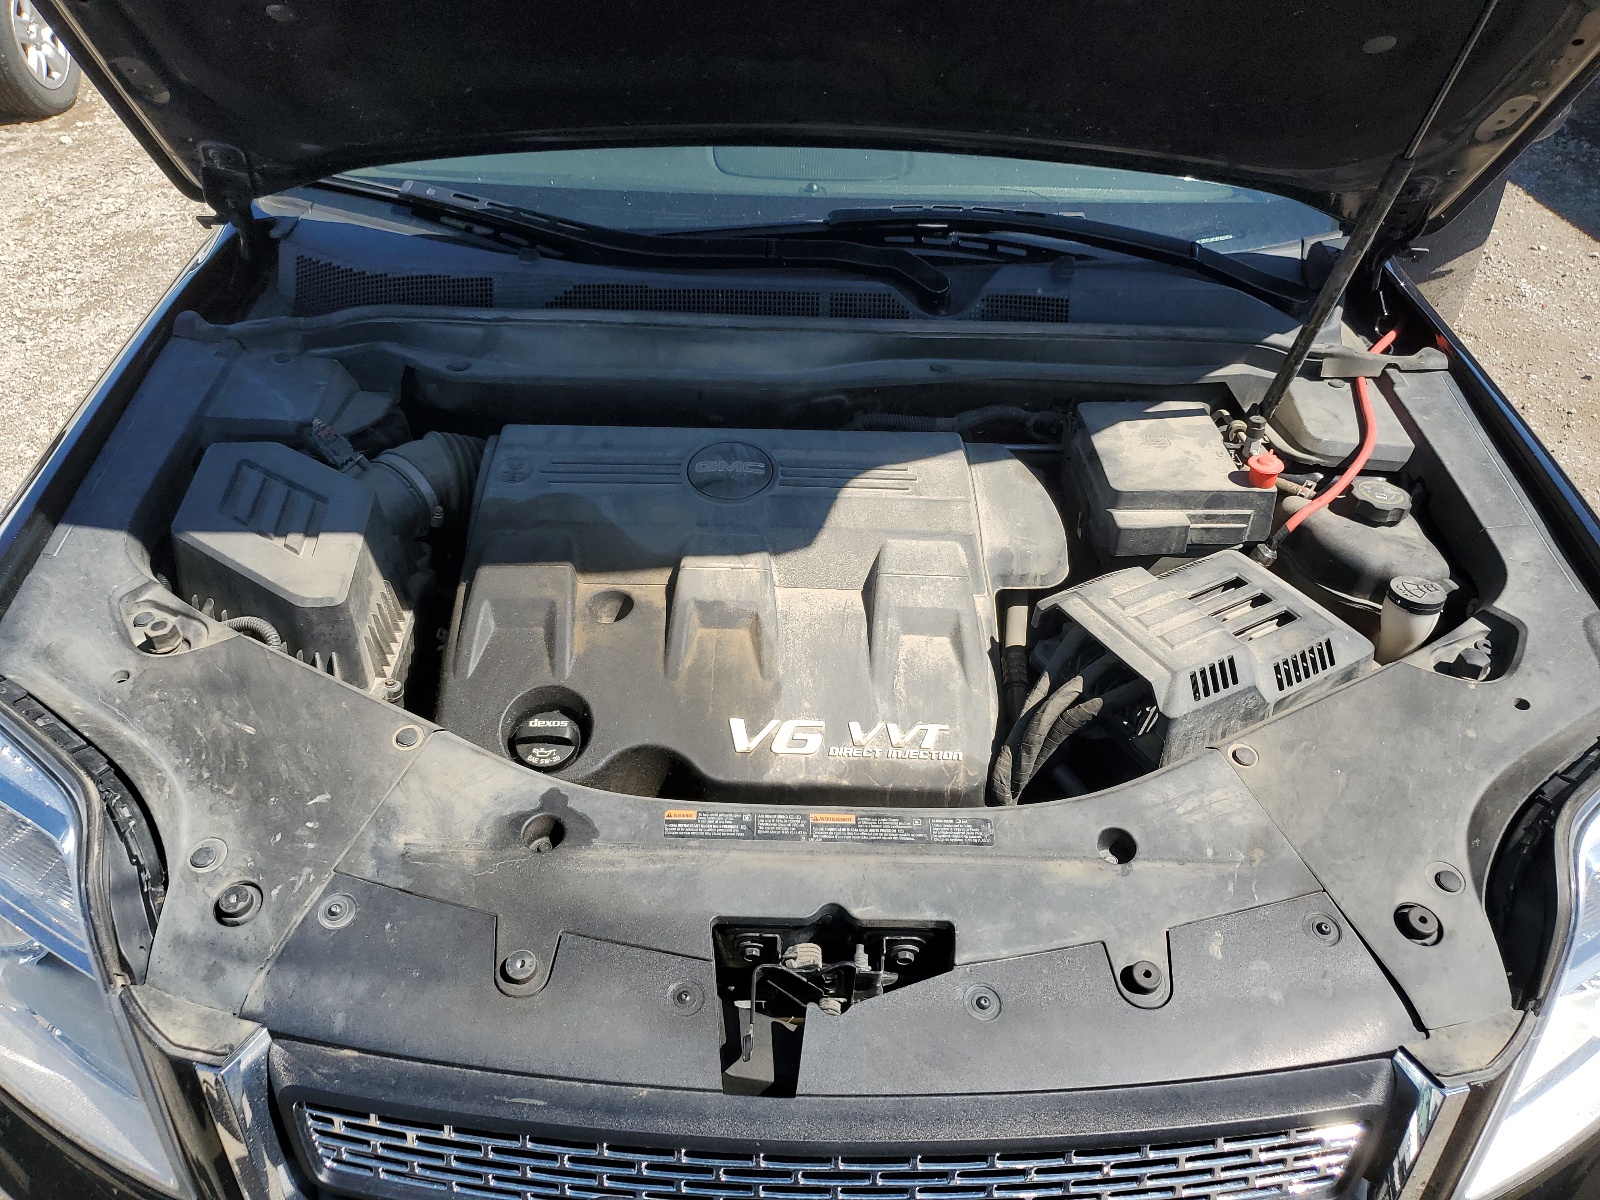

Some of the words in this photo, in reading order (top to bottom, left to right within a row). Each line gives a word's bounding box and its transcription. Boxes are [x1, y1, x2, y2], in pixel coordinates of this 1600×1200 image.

[695, 460, 766, 475] GMC
[528, 719, 570, 727] dexos
[728, 717, 826, 755] V6
[848, 720, 950, 749] VVT
[828, 746, 883, 758] DIRECT
[886, 747, 964, 762] INJECTION
